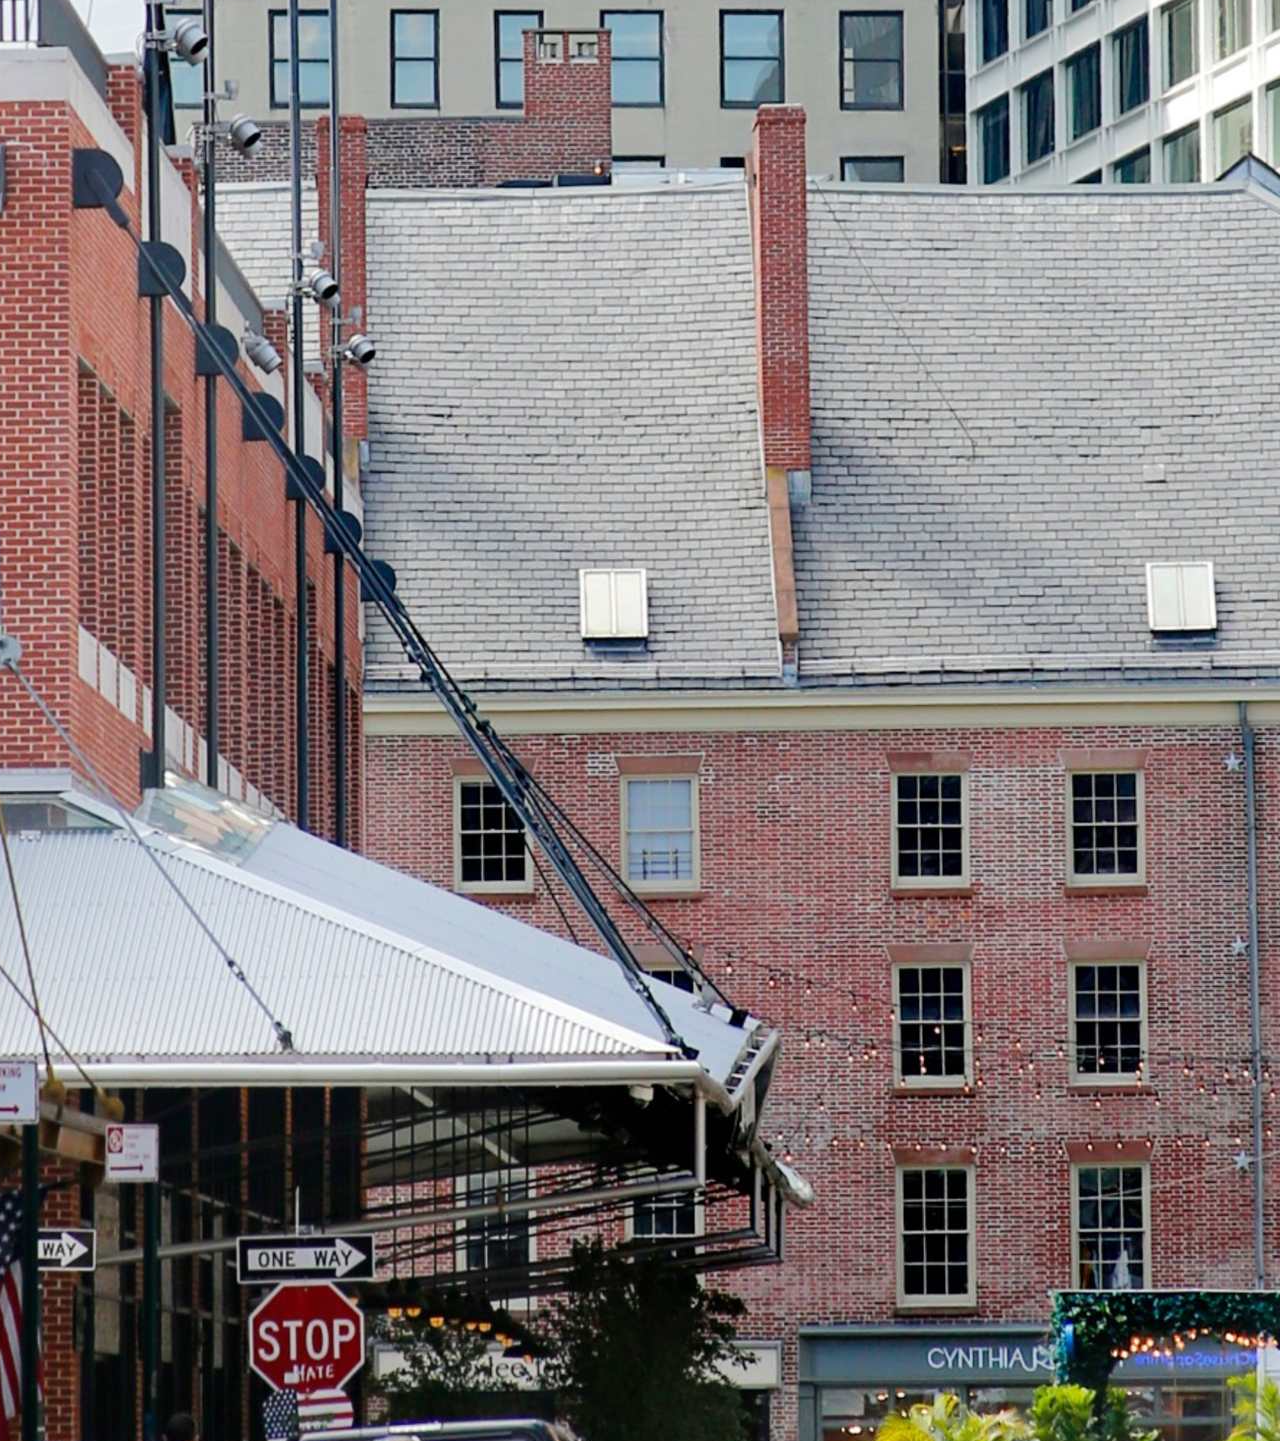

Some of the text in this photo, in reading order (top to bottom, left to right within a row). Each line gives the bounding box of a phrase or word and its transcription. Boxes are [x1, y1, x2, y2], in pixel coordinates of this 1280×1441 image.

[42, 1242, 77, 1257] WAY
[258, 1249, 352, 1268] ONE WAY
[257, 1318, 356, 1362] STOP
[293, 1363, 335, 1382] HATE
